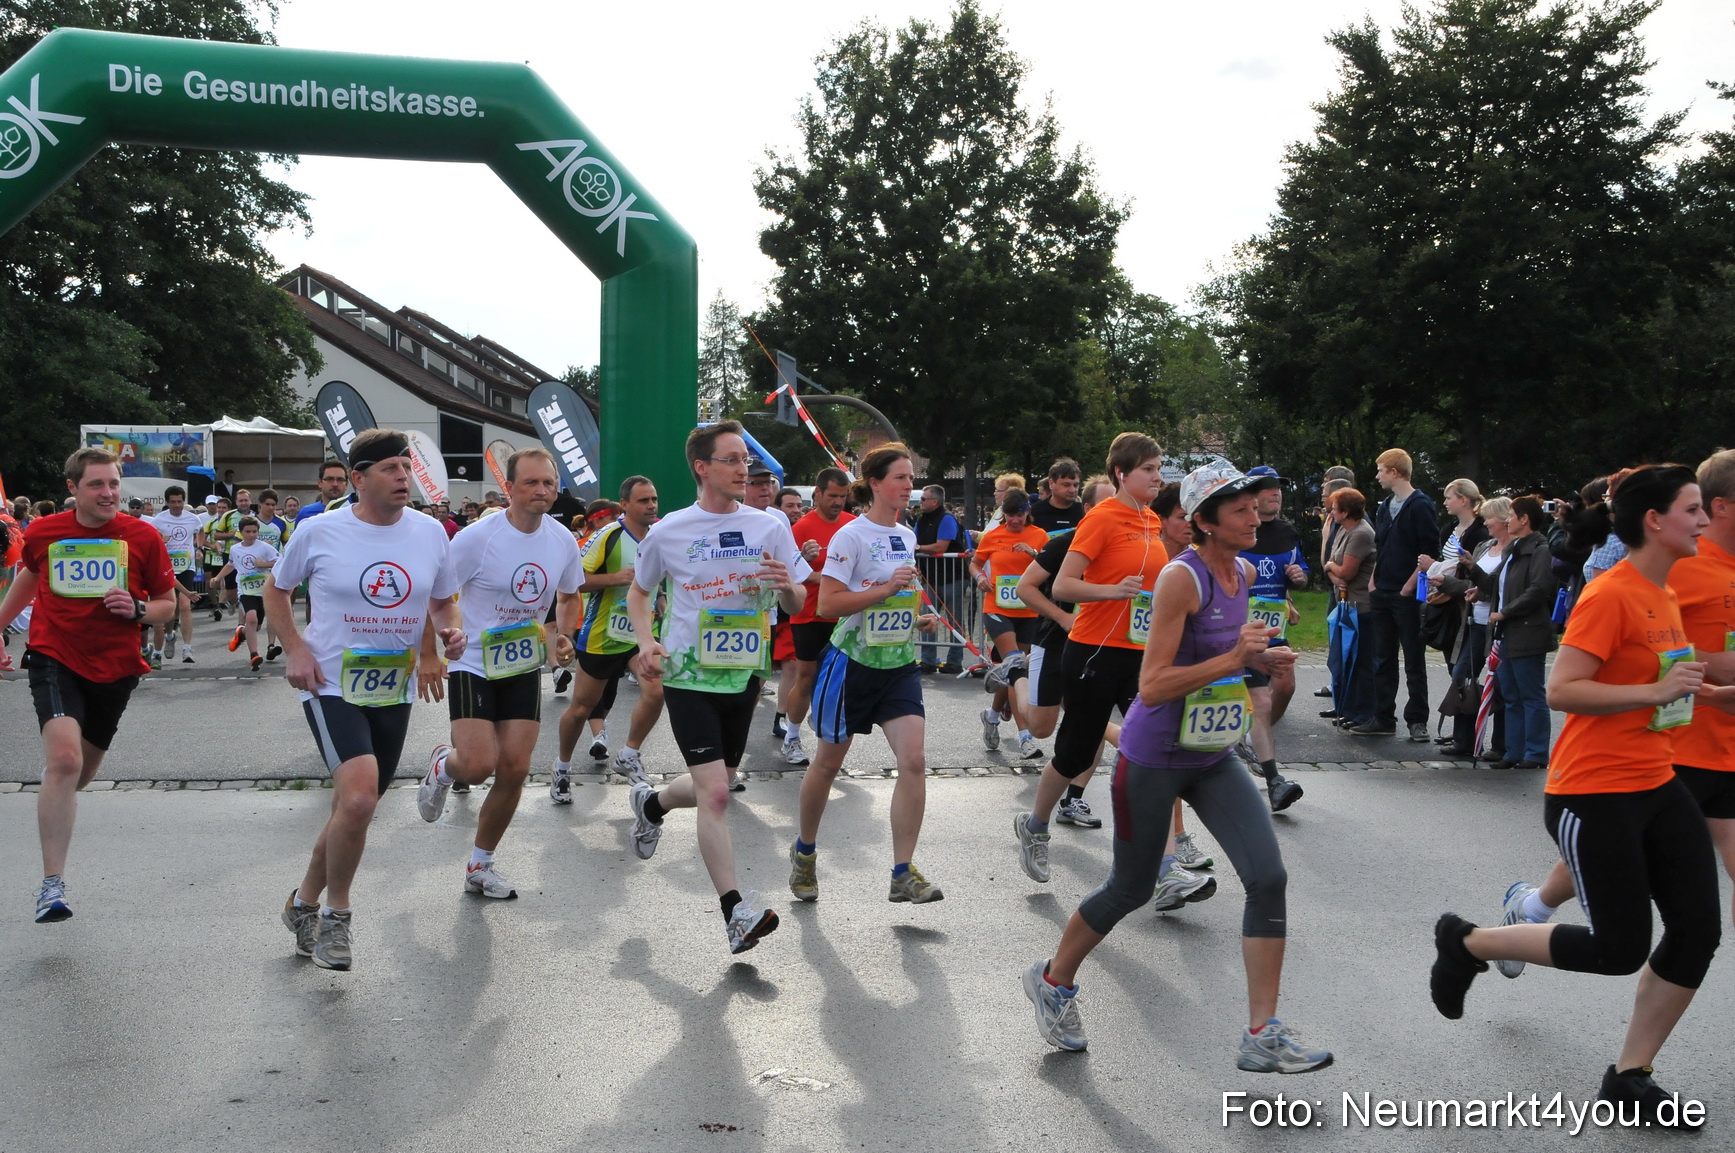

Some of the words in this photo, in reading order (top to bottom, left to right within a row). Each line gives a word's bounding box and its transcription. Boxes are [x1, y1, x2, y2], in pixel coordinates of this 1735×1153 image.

[108, 63, 163, 96] Die
[183, 70, 485, 118] Gesundheitskasse.
[514, 139, 660, 258] AOK
[142, 450, 192, 464] Logistics
[54, 560, 116, 581] 1300
[171, 557, 186, 567] 83
[701, 588, 735, 601] laufen
[867, 611, 912, 631] 1229
[489, 639, 533, 665] 788
[703, 630, 759, 653] 1230
[349, 669, 398, 692] 784
[1188, 704, 1242, 734] 1323
